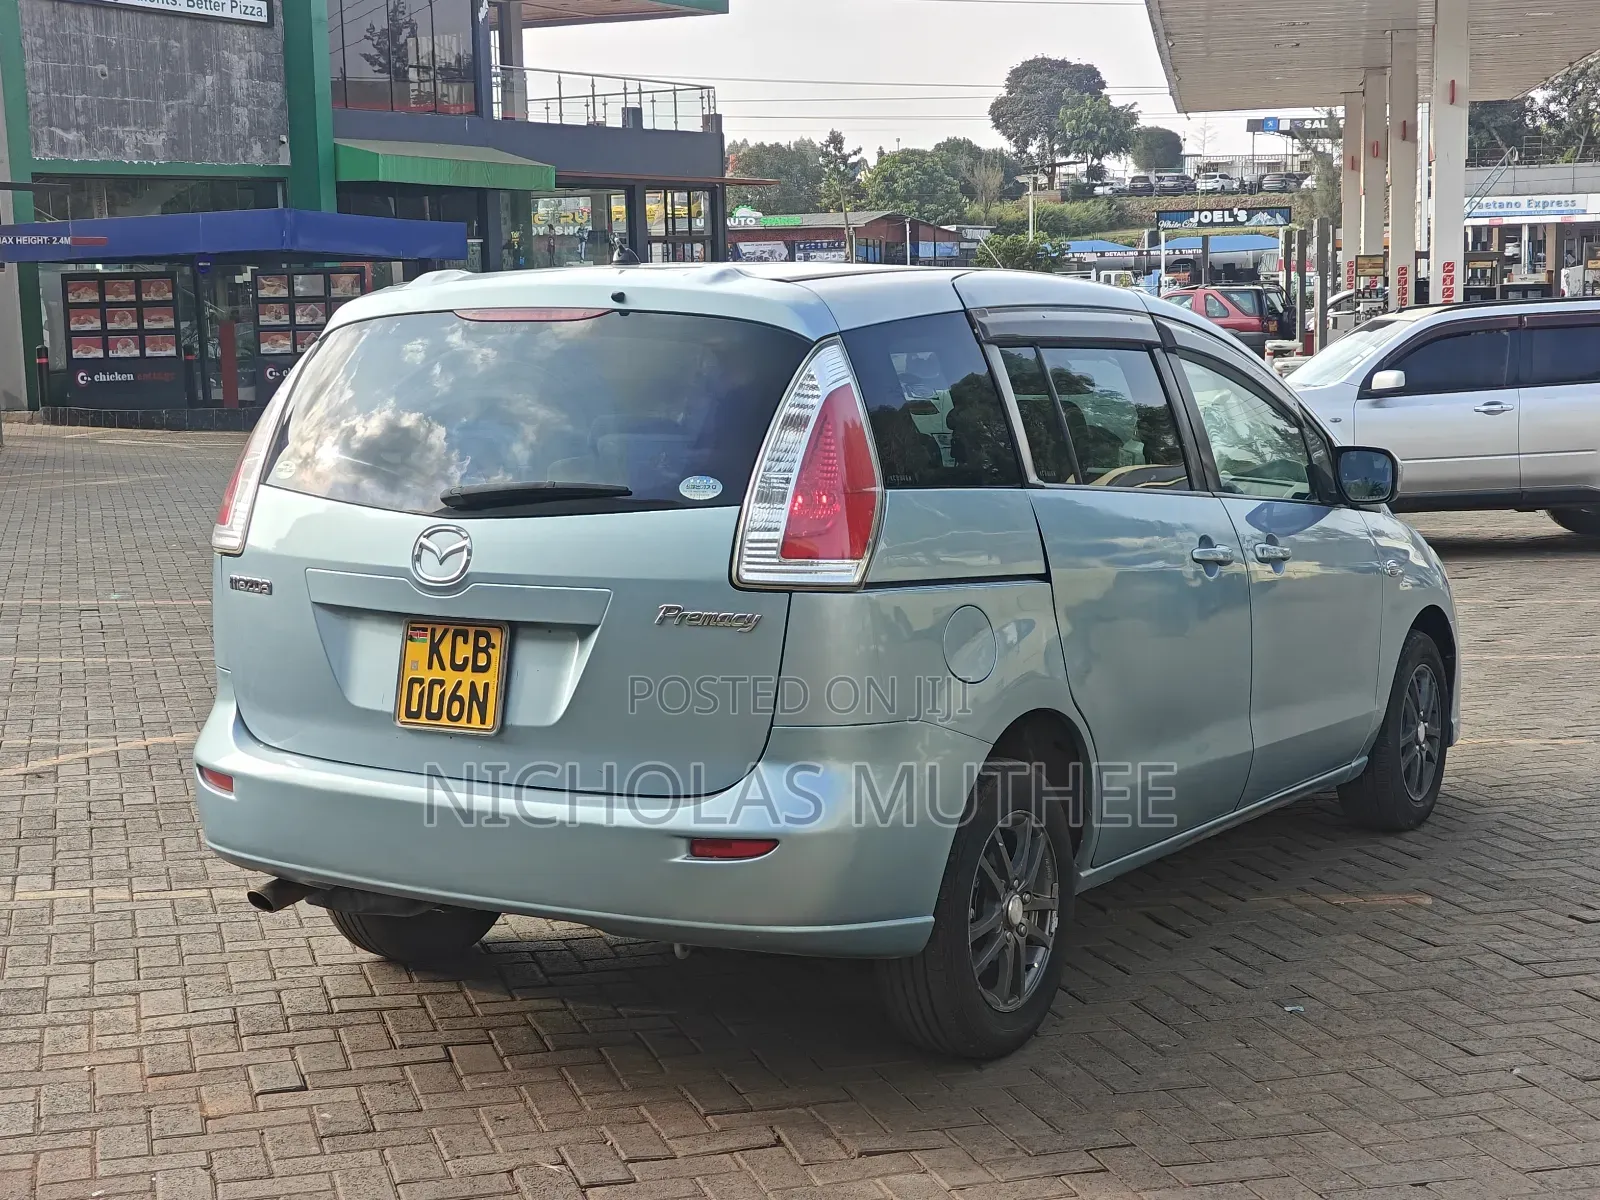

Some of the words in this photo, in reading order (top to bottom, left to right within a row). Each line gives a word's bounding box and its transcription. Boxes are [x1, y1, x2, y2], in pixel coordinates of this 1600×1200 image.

[230, 1, 267, 18] Pizza.
[1526, 198, 1576, 209] Express
[1189, 208, 1247, 223] JOEL'S
[1158, 220, 1181, 231] White
[16, 236, 51, 245] HEIGHT:
[52, 236, 71, 245] 2.4M
[94, 371, 134, 382] chicken
[654, 603, 763, 633] Premacy
[427, 627, 493, 674] KCB
[403, 675, 490, 726] 006N
